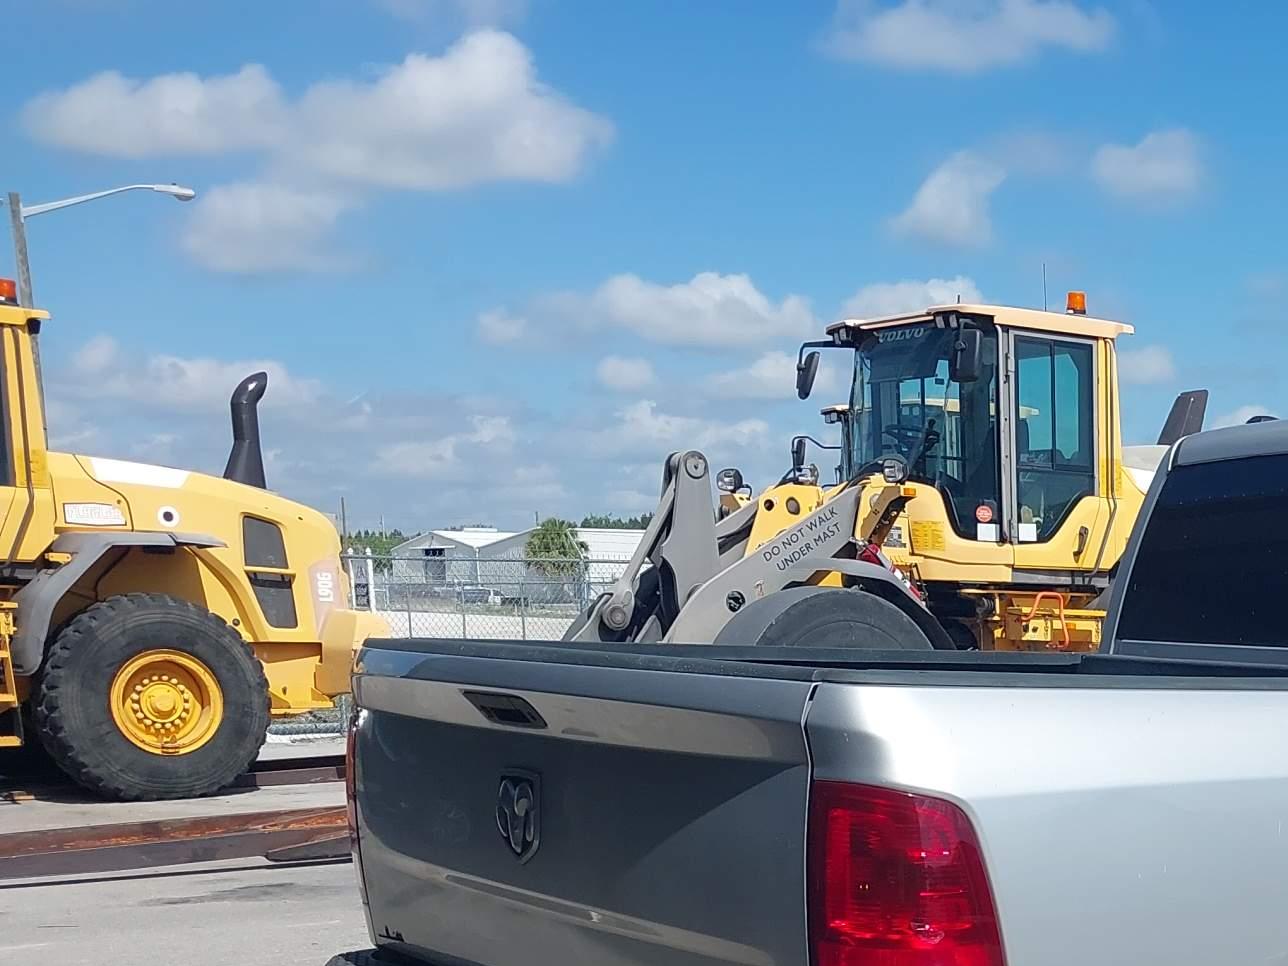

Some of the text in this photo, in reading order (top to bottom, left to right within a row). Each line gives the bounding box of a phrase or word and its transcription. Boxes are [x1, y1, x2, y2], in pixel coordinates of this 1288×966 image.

[879, 327, 924, 342] VOLVO
[763, 506, 839, 562] DO NOT WALK
[776, 521, 841, 571] UNDER MAST
